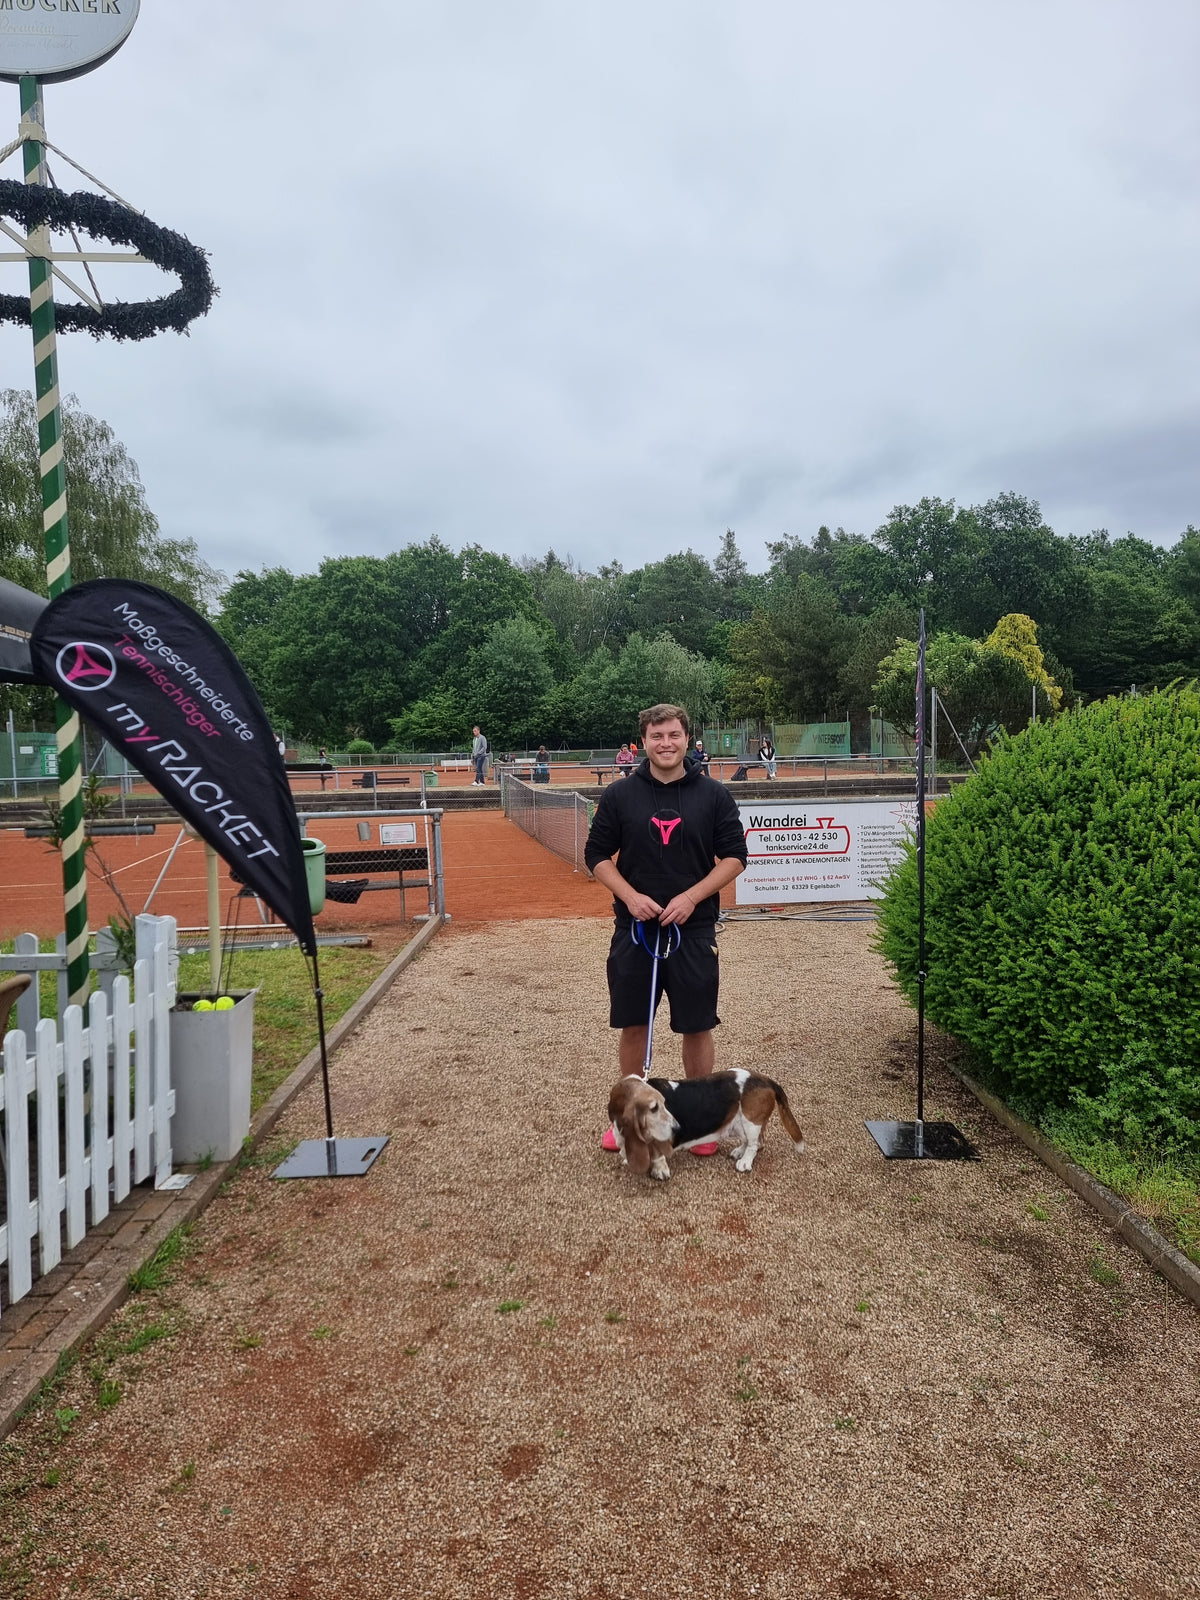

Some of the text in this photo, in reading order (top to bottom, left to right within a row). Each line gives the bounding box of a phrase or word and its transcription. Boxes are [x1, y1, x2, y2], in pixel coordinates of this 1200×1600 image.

[113, 602, 255, 742] Maßgeschneiderte
[114, 633, 222, 738] Tennischläger
[749, 814, 807, 828] Wandrei
[759, 834, 773, 843] Tel.
[775, 833, 802, 842] 06103
[808, 833, 819, 841] 42
[821, 832, 838, 841] 530
[766, 842, 829, 852] tankservice24.de
[747, 858, 784, 866] ANKSERVICE
[792, 856, 851, 864] TANKDEMONTAGEN
[810, 883, 841, 891] Egelsbach
